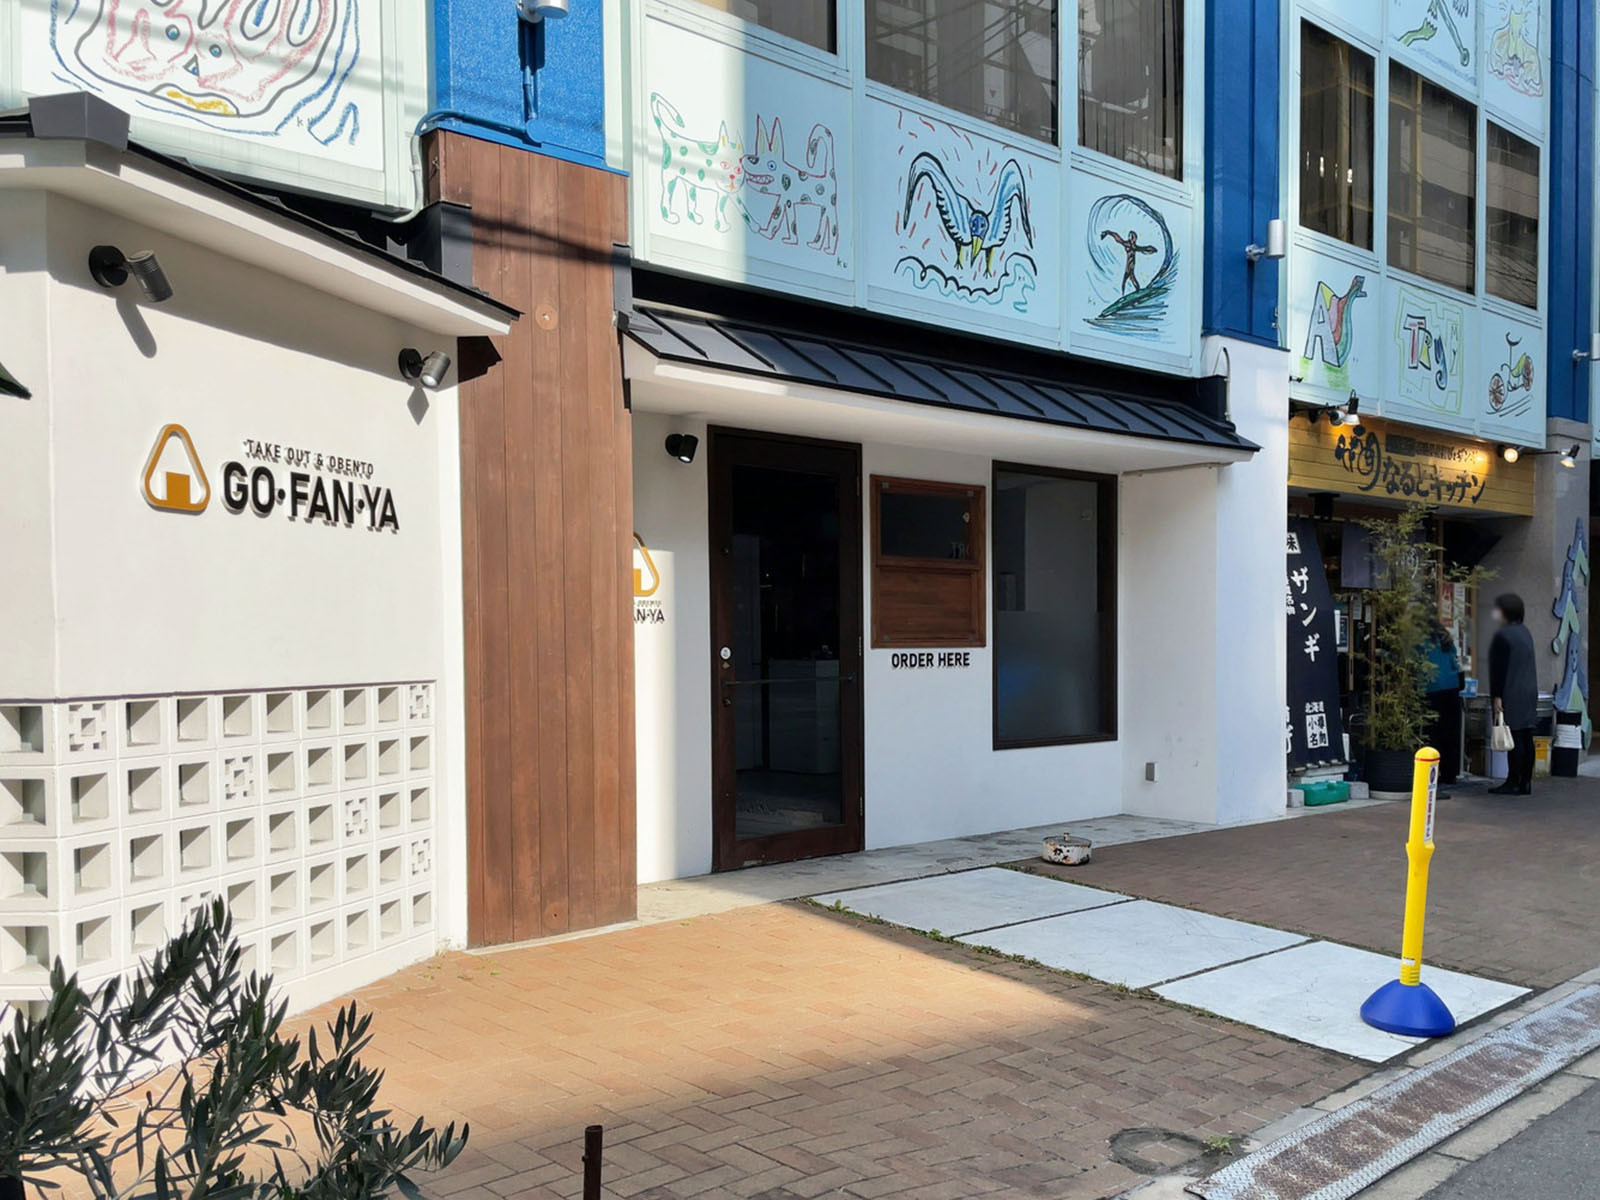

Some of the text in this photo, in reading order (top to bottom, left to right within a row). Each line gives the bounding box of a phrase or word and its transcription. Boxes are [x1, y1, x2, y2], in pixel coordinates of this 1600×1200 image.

[246, 439, 374, 476] TAKE OUT & OBENTO
[1290, 566, 1320, 662] ザンギ
[891, 652, 970, 668] ORDER HERE
